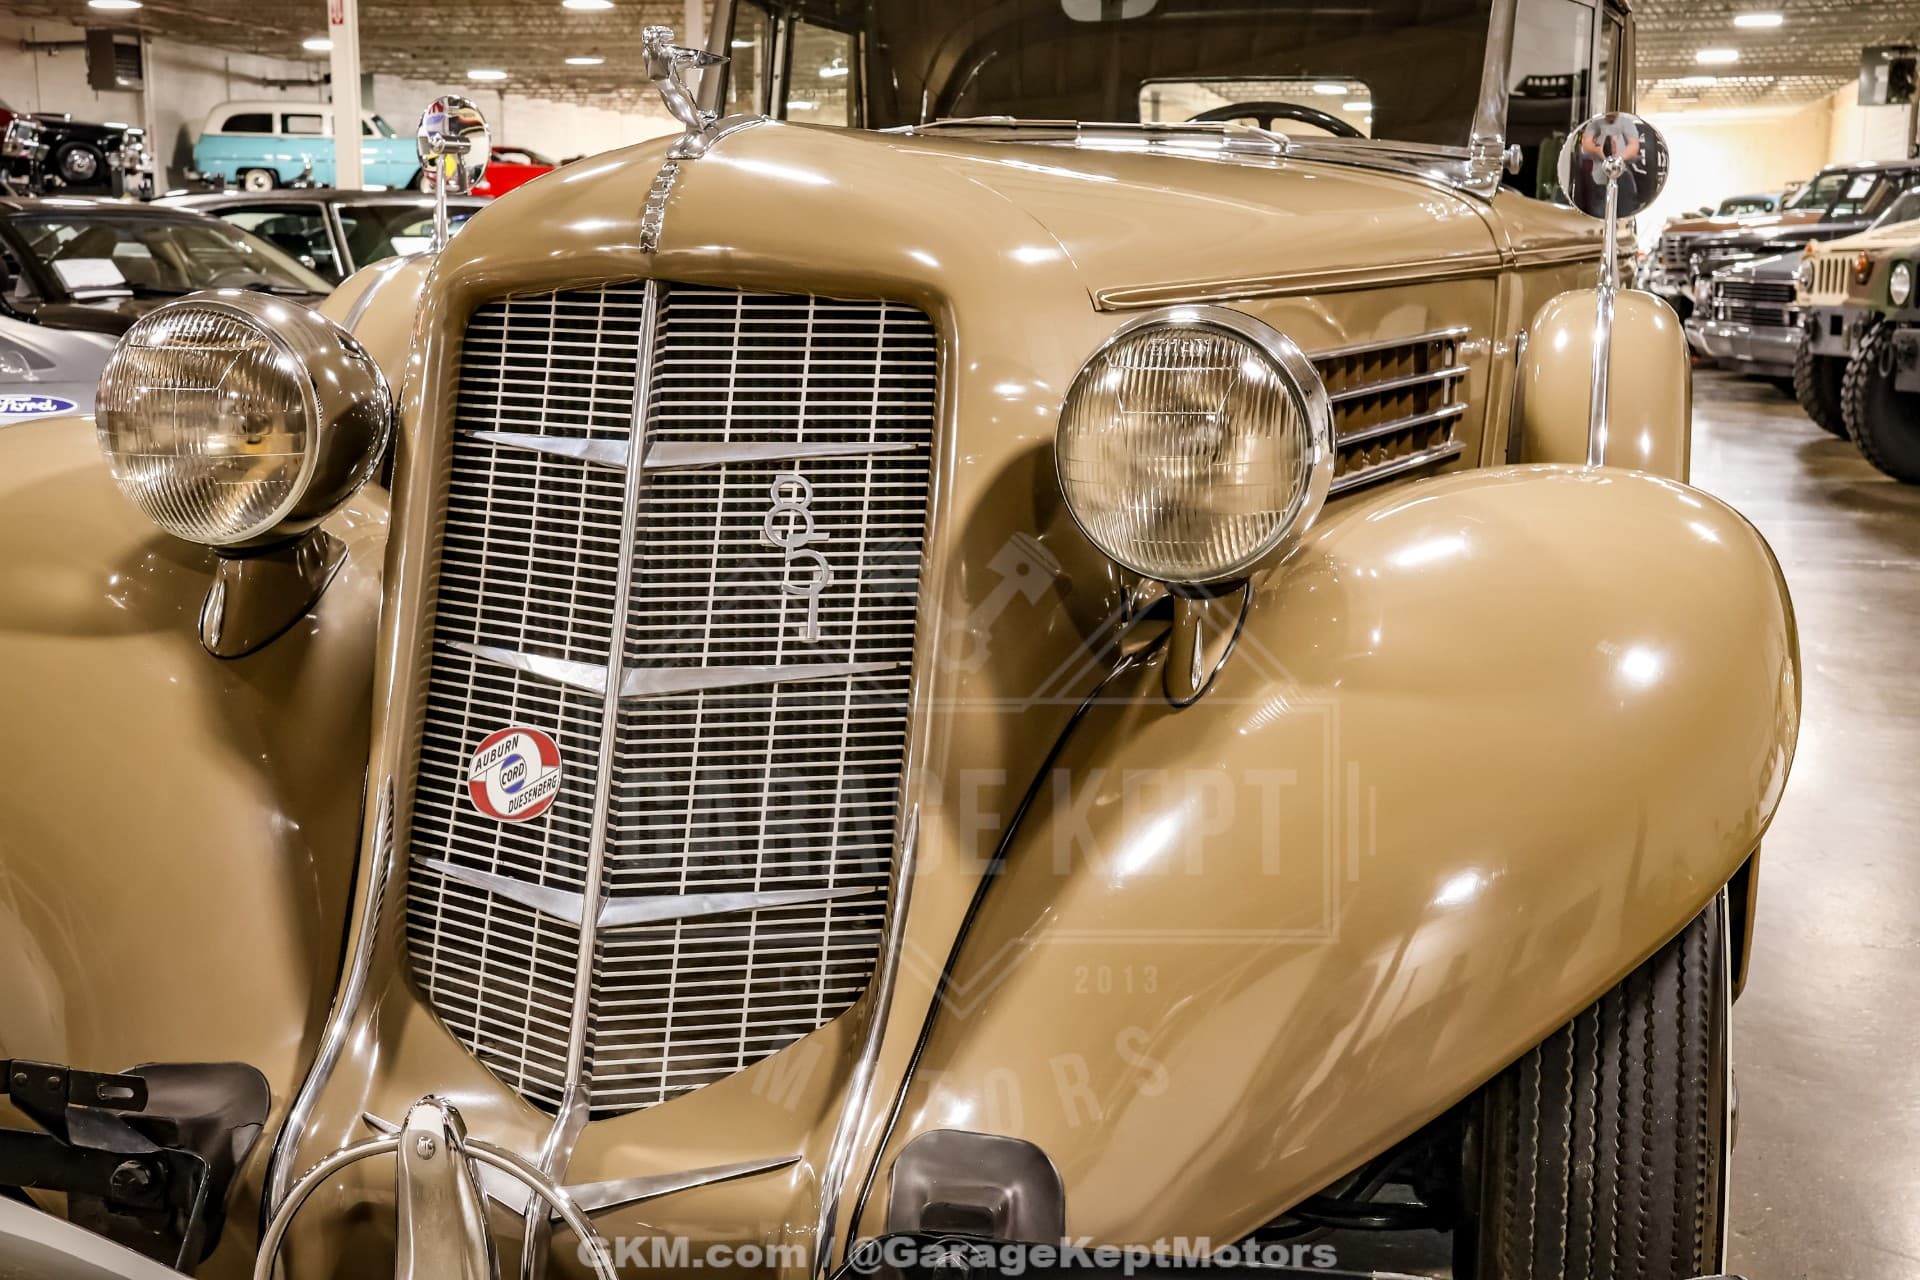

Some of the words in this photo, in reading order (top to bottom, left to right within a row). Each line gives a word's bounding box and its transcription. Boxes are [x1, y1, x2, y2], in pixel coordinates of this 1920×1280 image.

[474, 735, 520, 773] AUBURN
[501, 762, 525, 786] CORD
[508, 774, 558, 814] DUESENBERG
